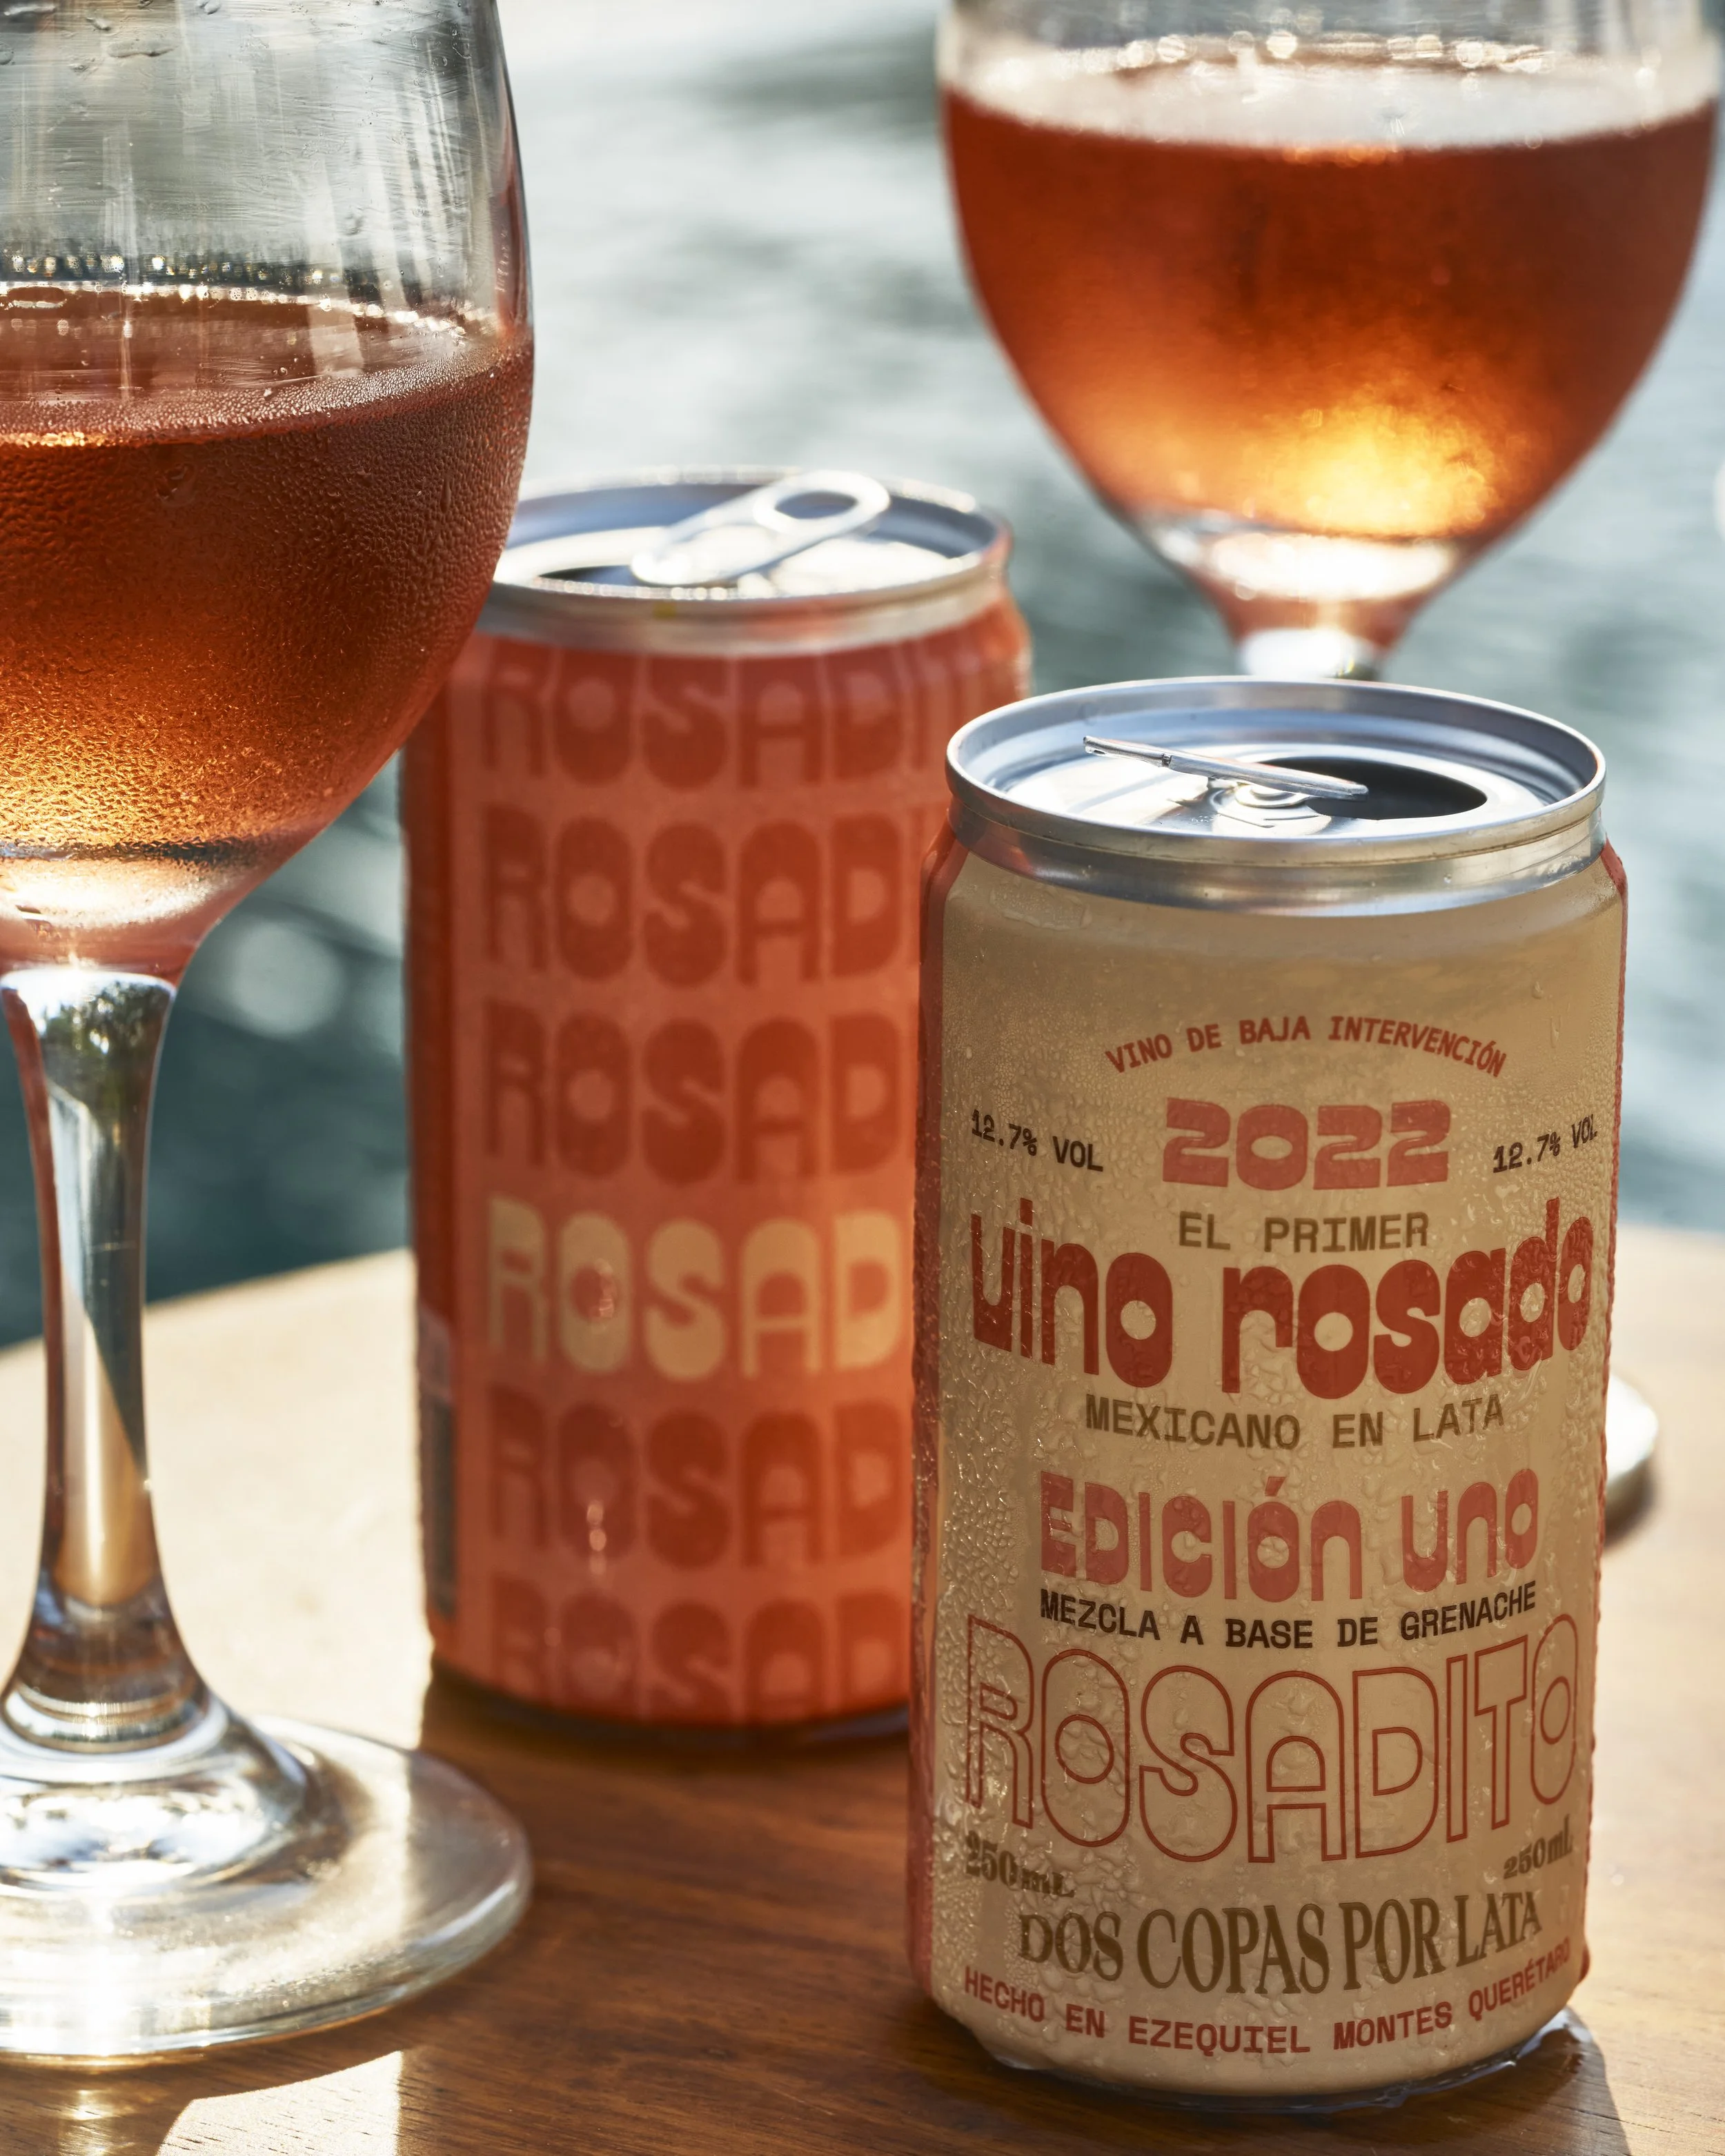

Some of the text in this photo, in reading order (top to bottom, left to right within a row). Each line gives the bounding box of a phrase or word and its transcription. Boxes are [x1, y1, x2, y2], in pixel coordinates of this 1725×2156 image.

[1105, 1016, 1507, 1078] VINO DE BAJA INTERVENCIÓN
[971, 1109, 1103, 1172] 12.7% VOL
[1163, 1097, 1451, 1191] 2022
[1493, 1114, 1598, 1173] 12.7% VOL
[1179, 1211, 1429, 1252] EL PRIMER
[1222, 1196, 1595, 1399] rosado
[1085, 1393, 1505, 1450] MEXICANO EN LATA
[1040, 1581, 1537, 1649] MEZCLA A BASE DE GRENACHE
[967, 1614, 1579, 1863] ROSADITO
[1019, 1892, 1543, 1995] DOS COPAS POR LATA
[965, 1935, 1571, 2056] HECHO EN EZEQUIEL MONTES QUERÉTARO
